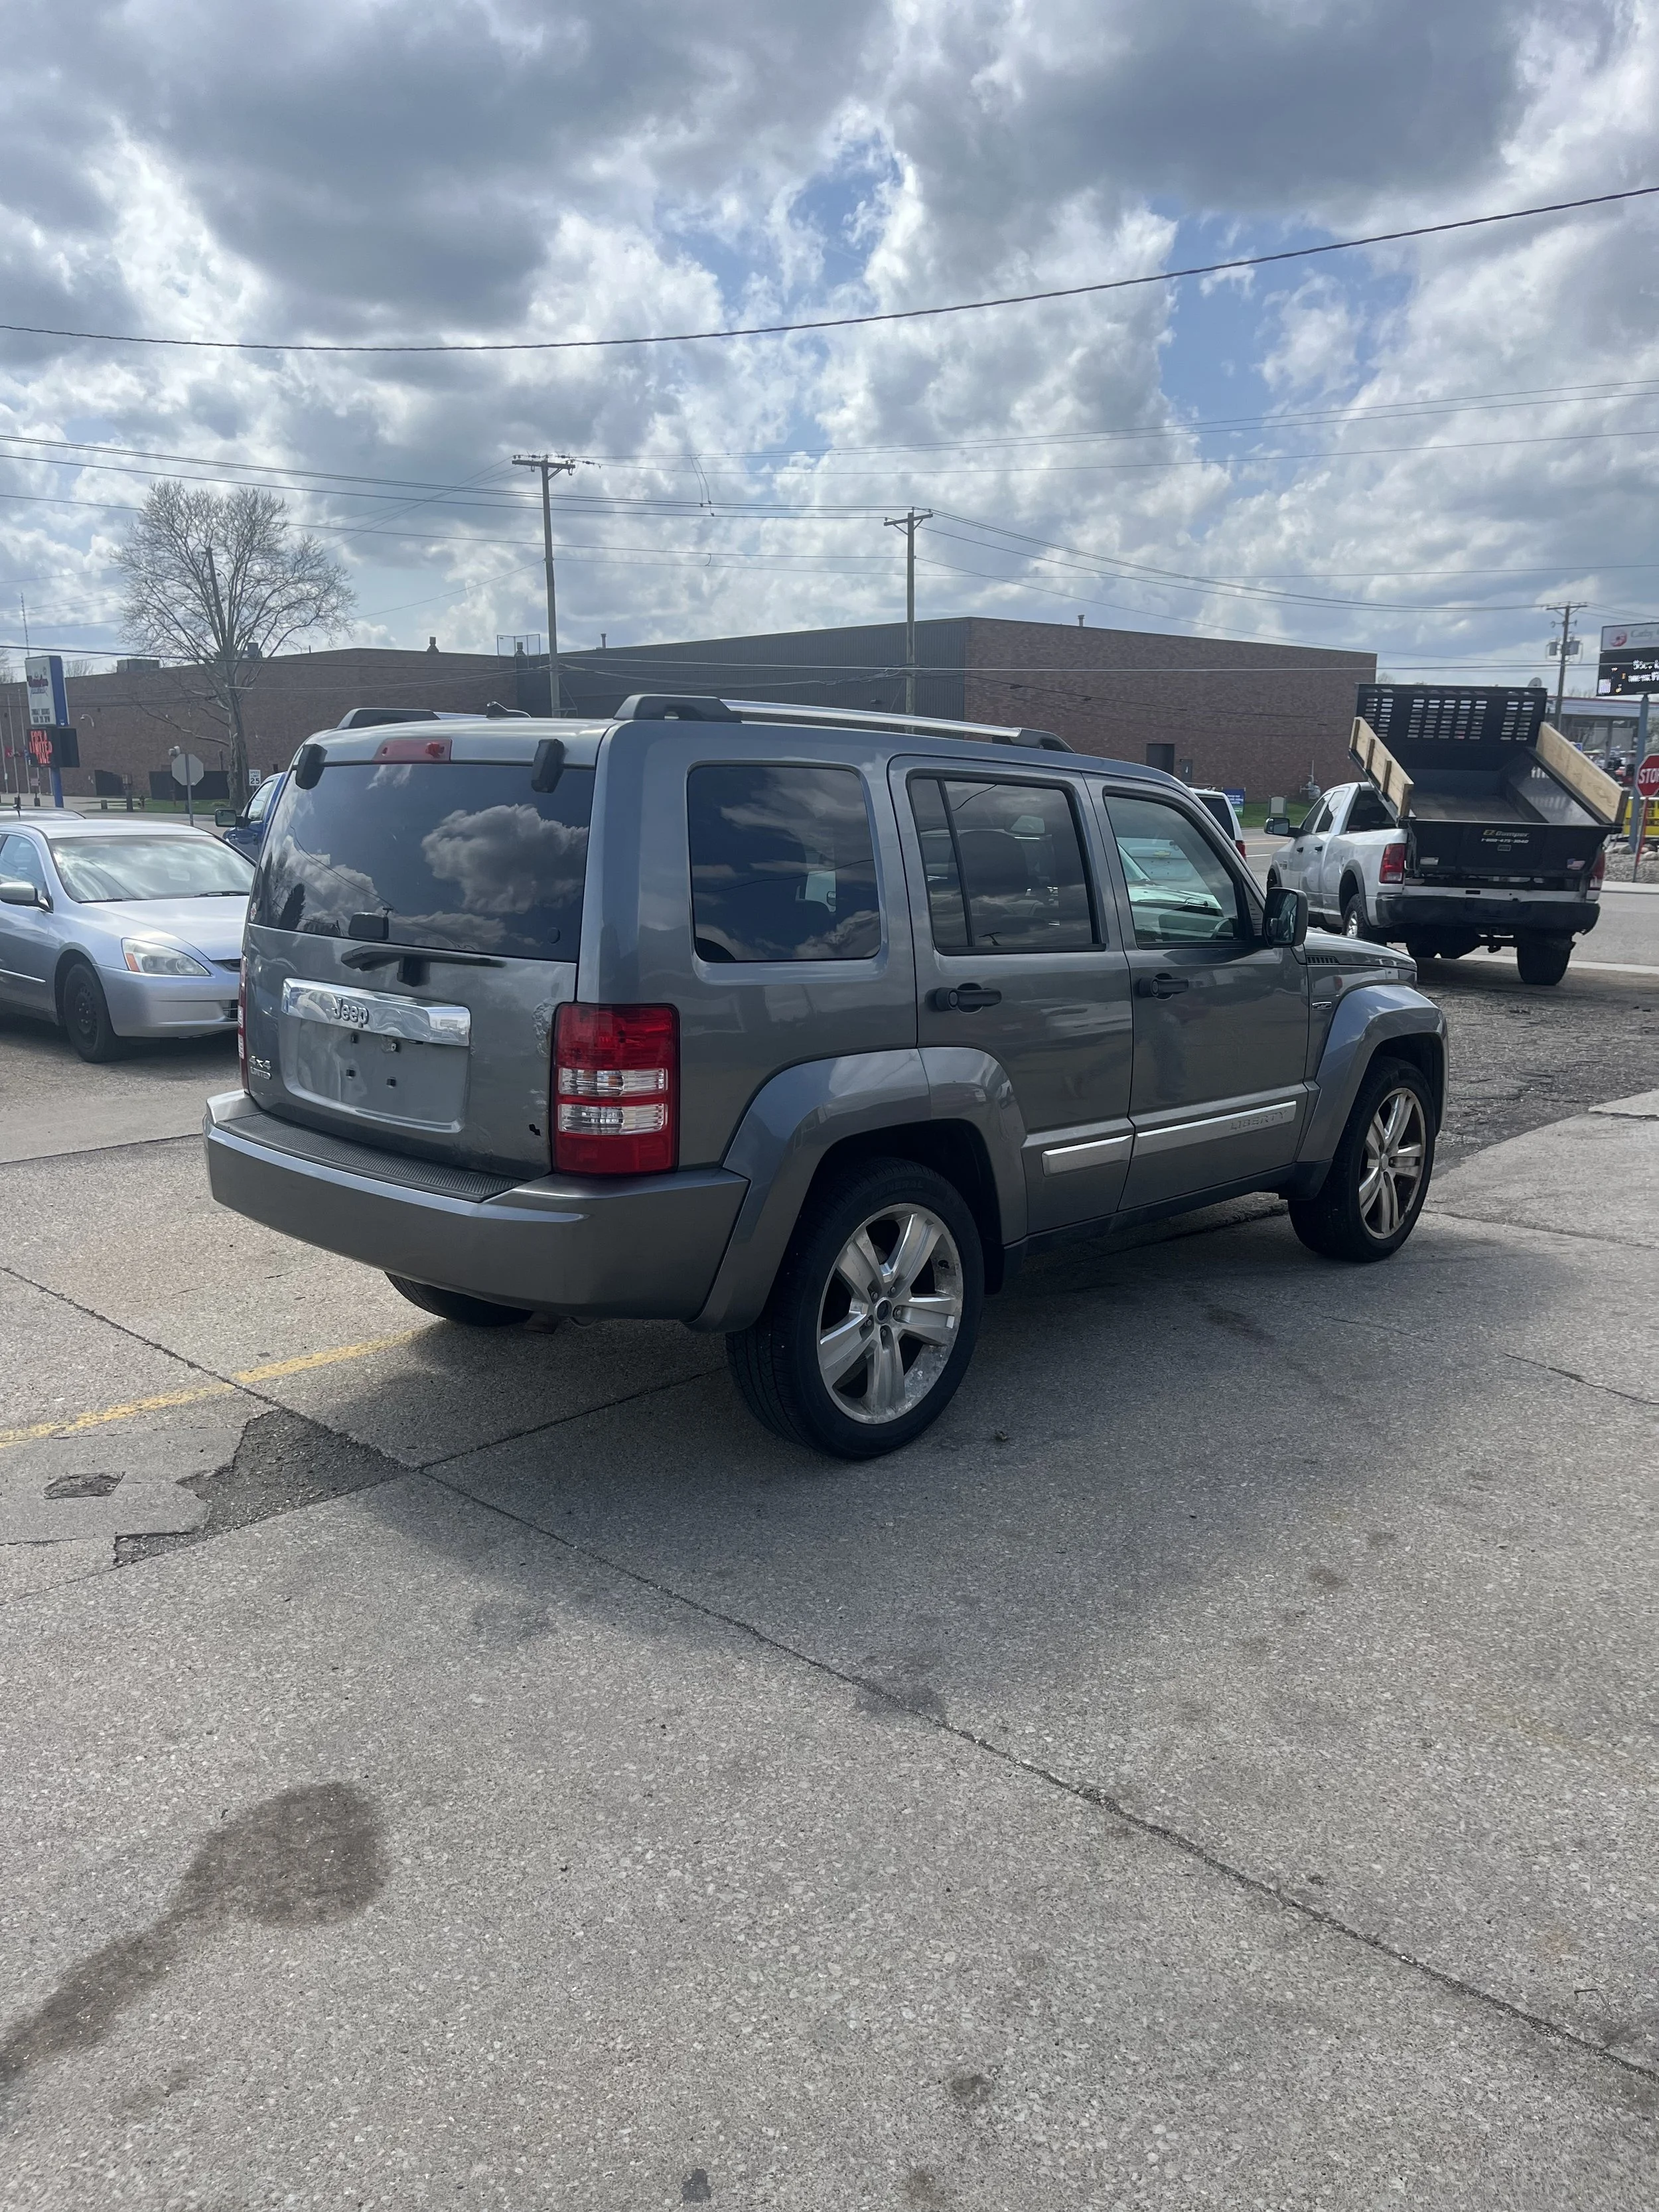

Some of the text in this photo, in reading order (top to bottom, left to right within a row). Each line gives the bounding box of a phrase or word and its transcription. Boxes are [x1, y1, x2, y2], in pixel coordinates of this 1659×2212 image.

[31, 730, 42, 742] FOR
[29, 741, 52, 753] LIMITED
[36, 752, 50, 764] TIME
[331, 998, 369, 1028] Jeep
[1229, 1110, 1289, 1132] LIBERTY
